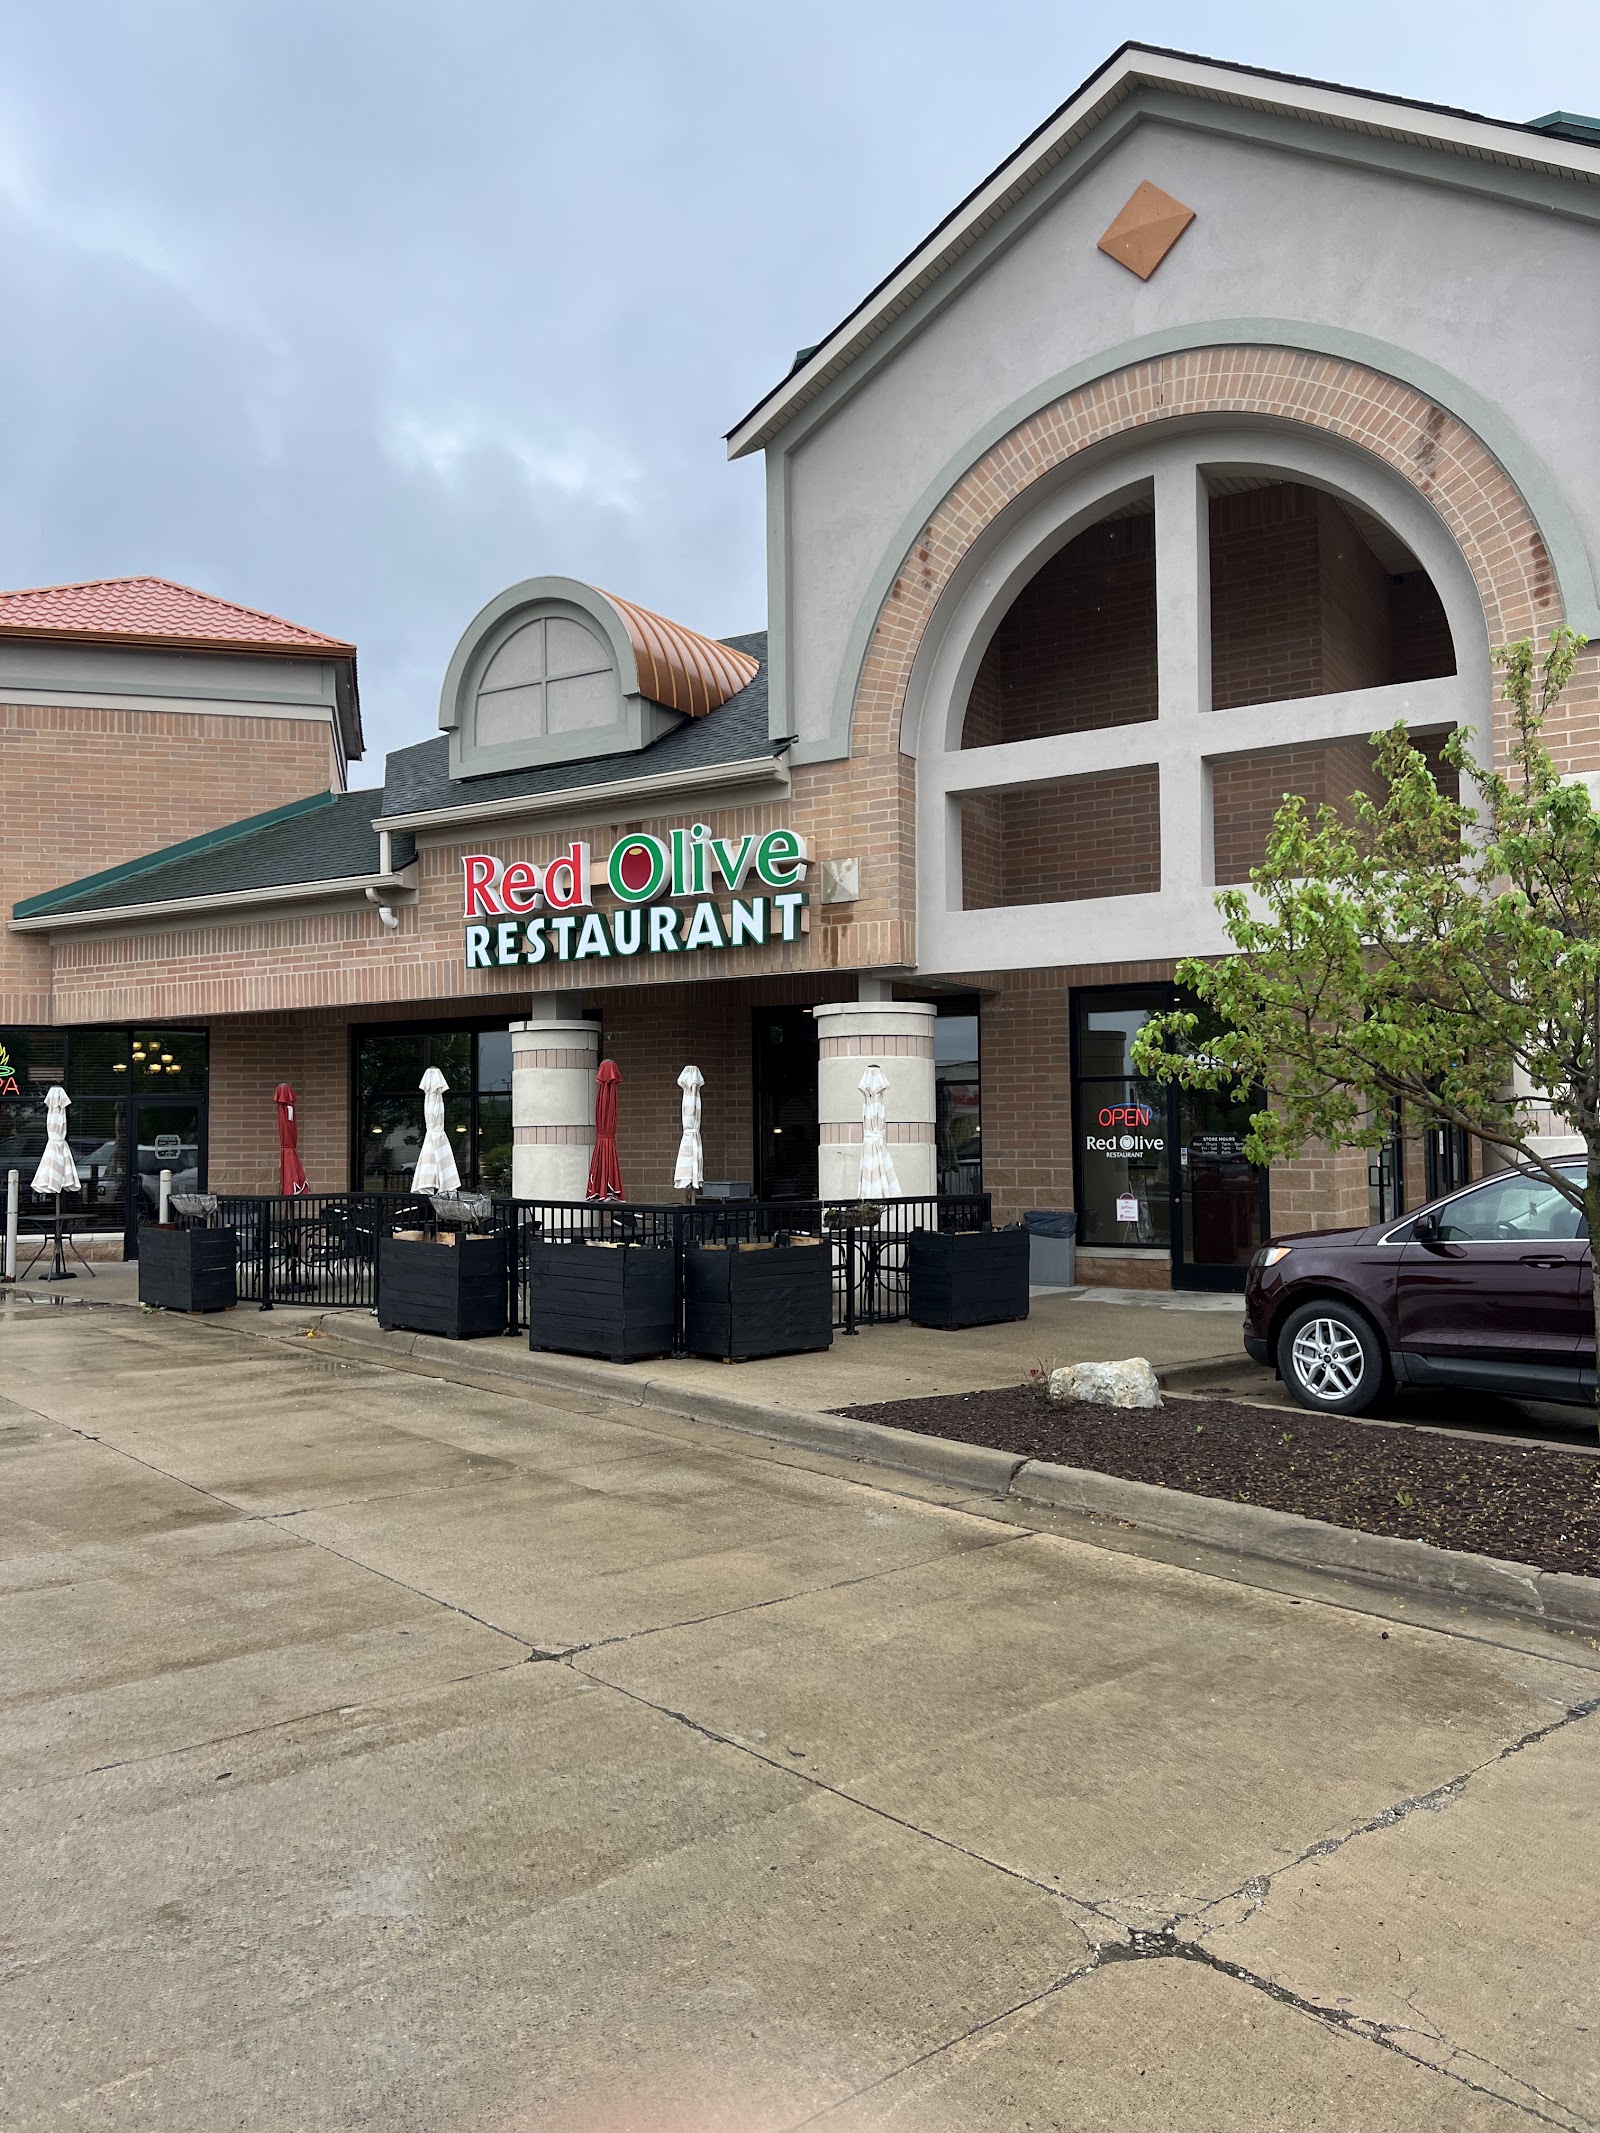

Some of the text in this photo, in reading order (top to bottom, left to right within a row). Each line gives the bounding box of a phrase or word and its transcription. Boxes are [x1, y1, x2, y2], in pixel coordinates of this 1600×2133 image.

[461, 823, 810, 918] Red Olive
[465, 892, 809, 969] RESTAURANT
[1098, 1108, 1150, 1127] OPEN
[1086, 1135, 1164, 1151] Red Olive
